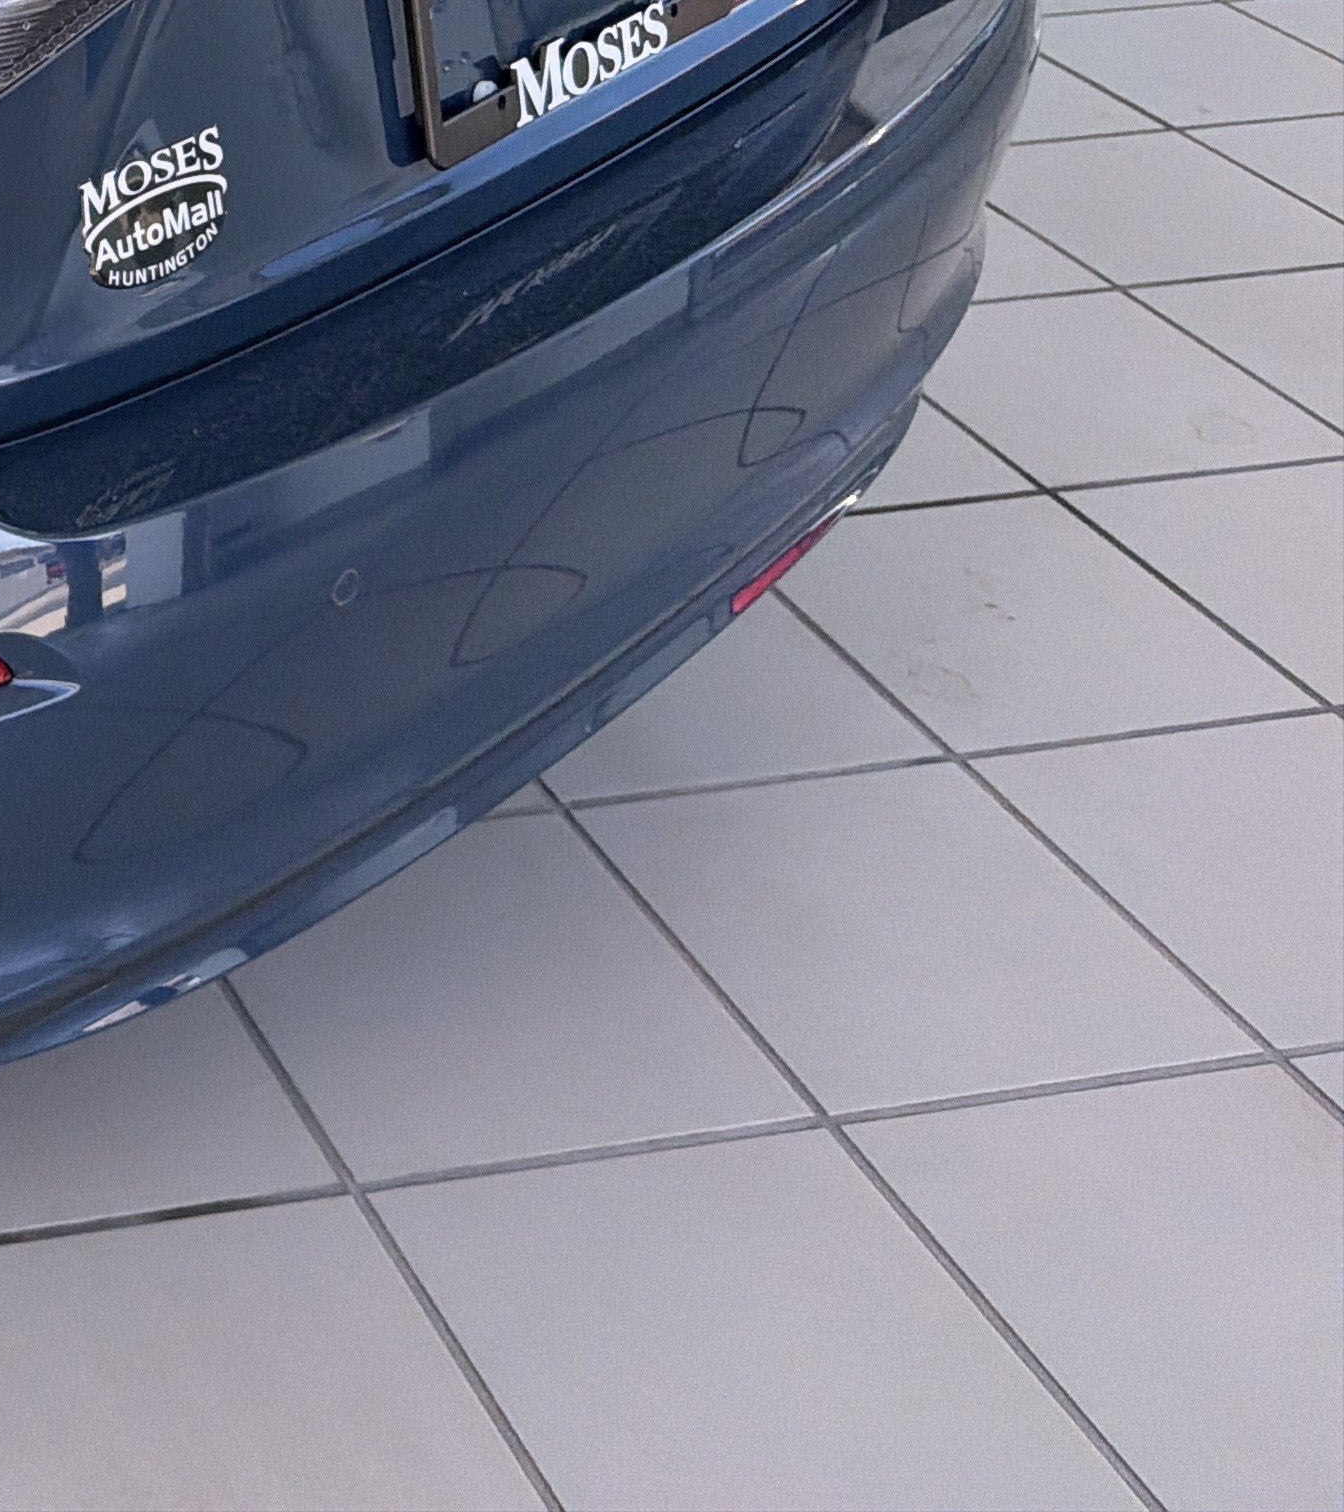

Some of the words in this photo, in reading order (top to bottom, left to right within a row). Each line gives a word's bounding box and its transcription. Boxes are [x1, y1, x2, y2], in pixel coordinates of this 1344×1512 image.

[510, 1, 668, 128] MOSES
[78, 124, 224, 237] MOSES
[94, 189, 224, 271] AutoMall
[108, 222, 218, 286] HUNTINGTON
